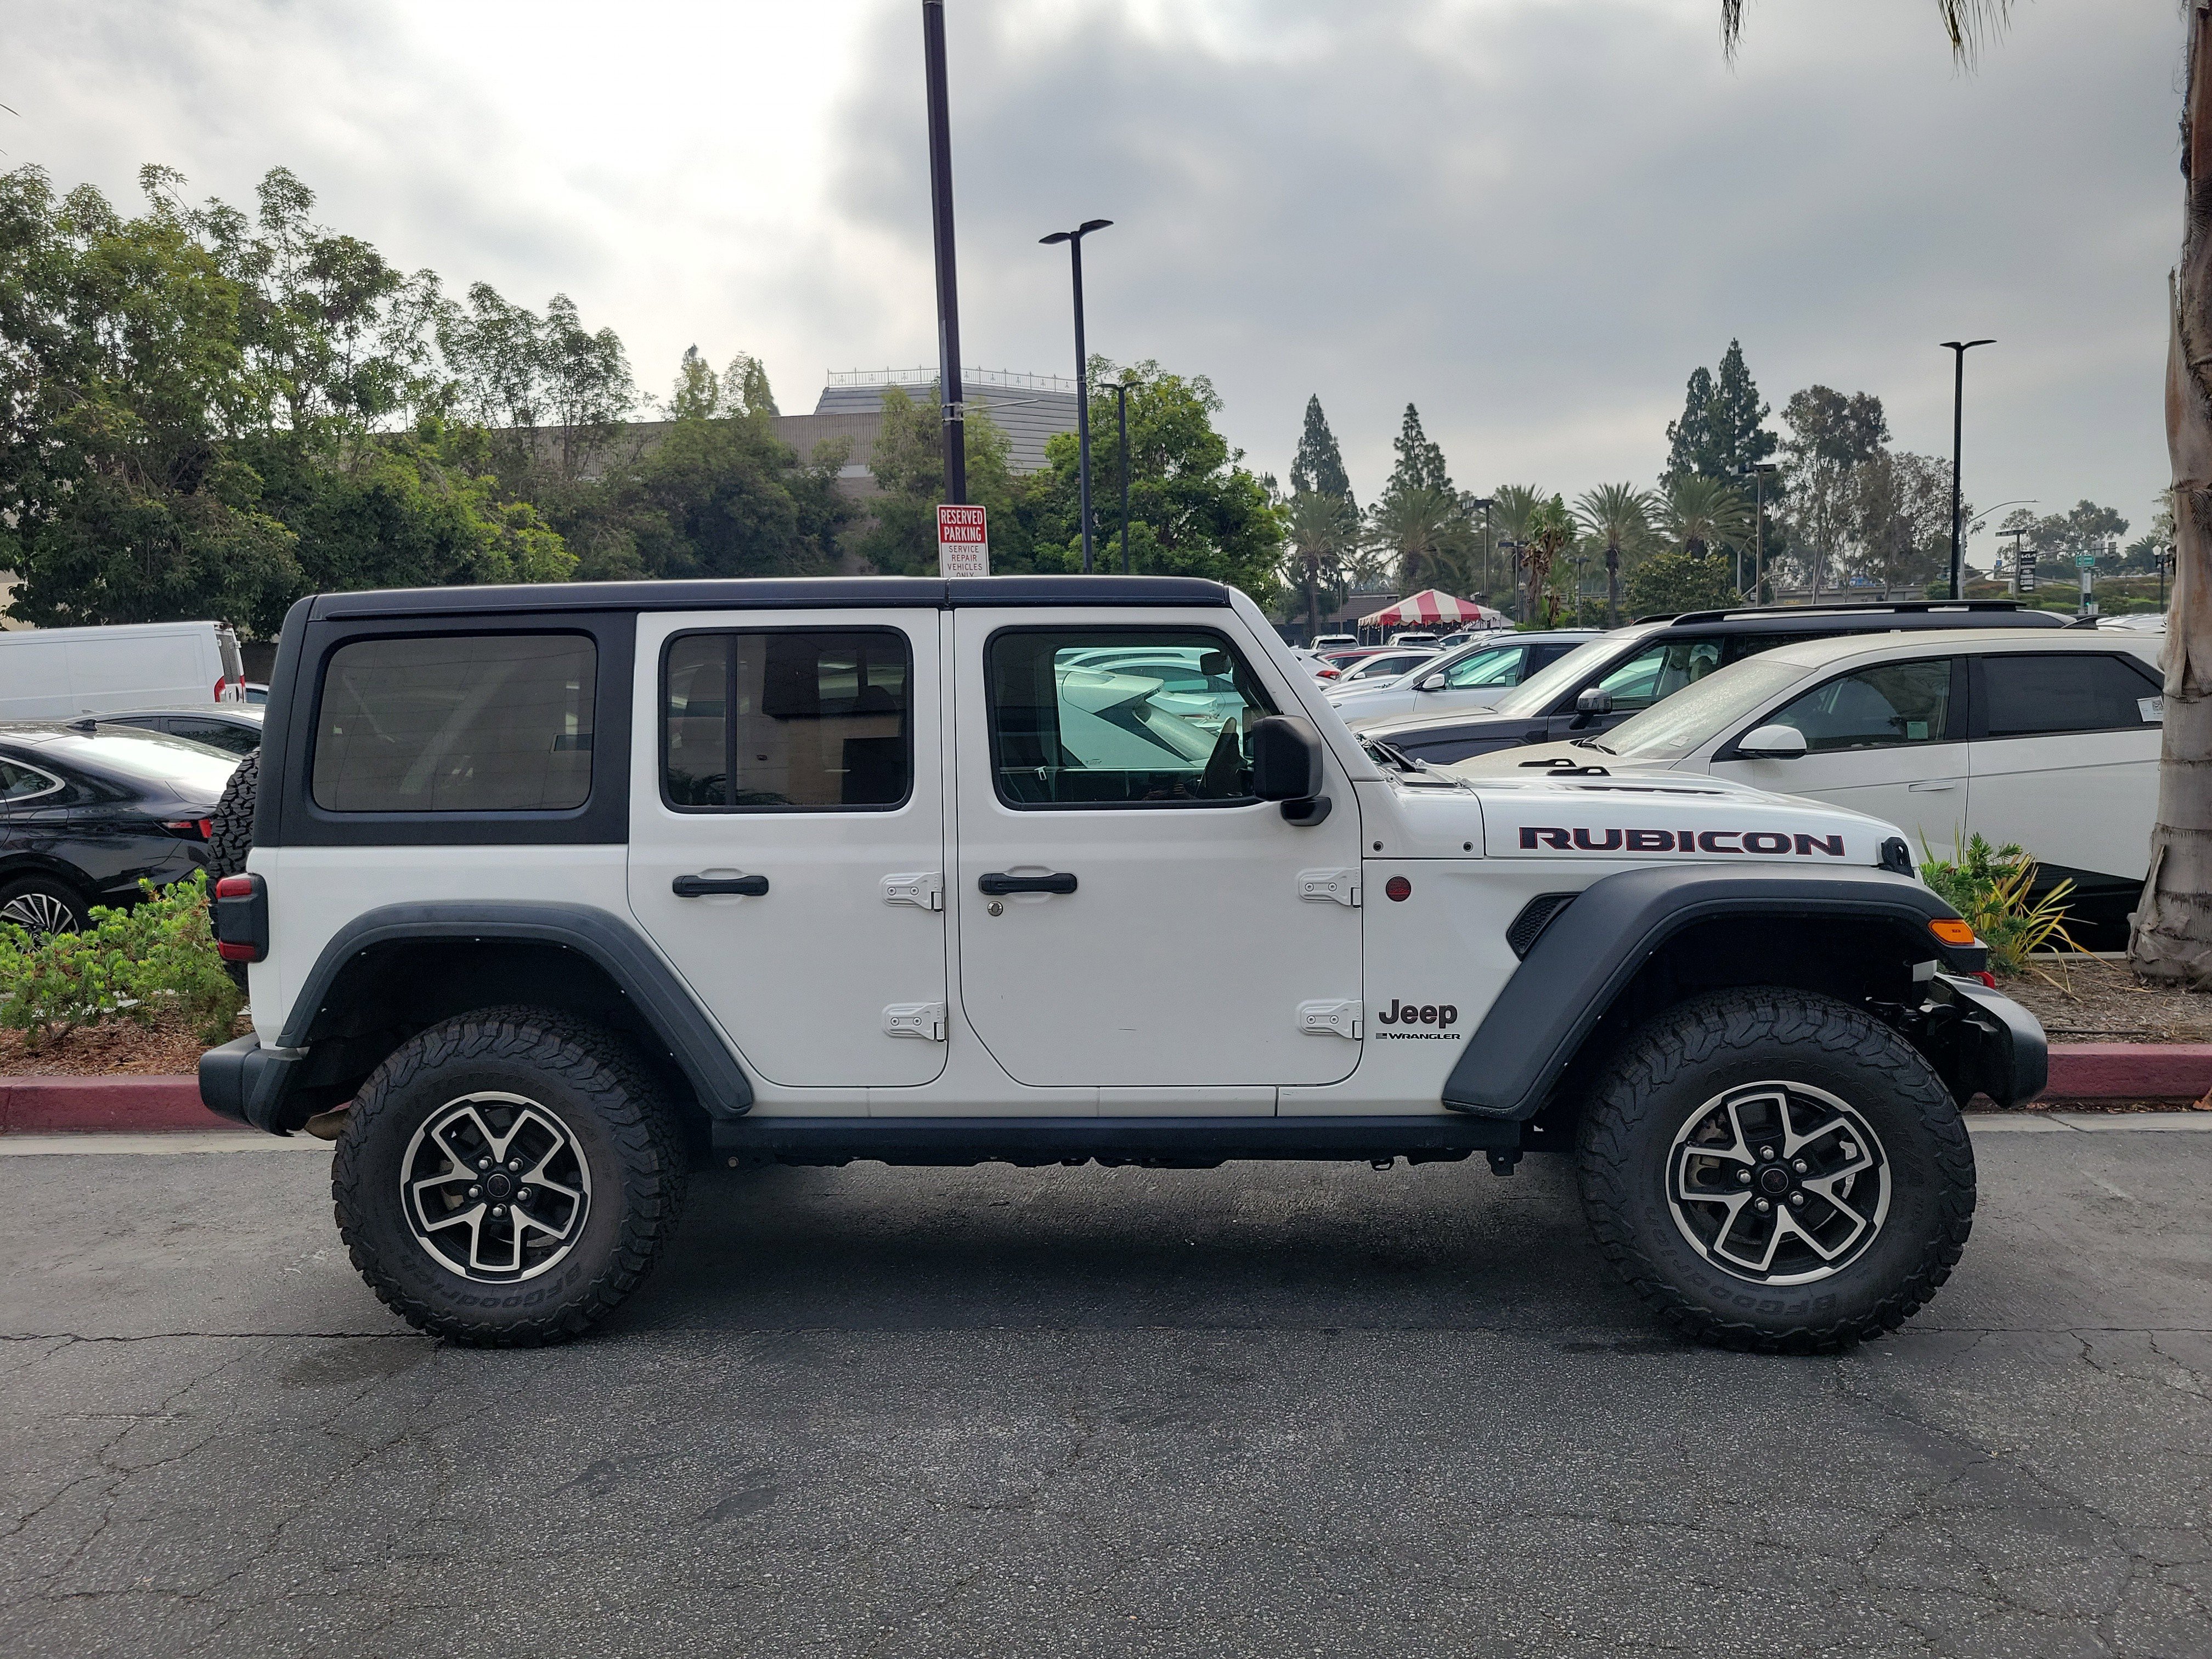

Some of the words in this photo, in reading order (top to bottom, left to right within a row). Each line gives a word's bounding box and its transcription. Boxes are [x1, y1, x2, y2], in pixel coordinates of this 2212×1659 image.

[940, 510, 983, 524] RESERVED
[944, 526, 981, 541] PARKING
[1519, 827, 1846, 856] RUBICON
[1379, 999, 1458, 1029] Jeep
